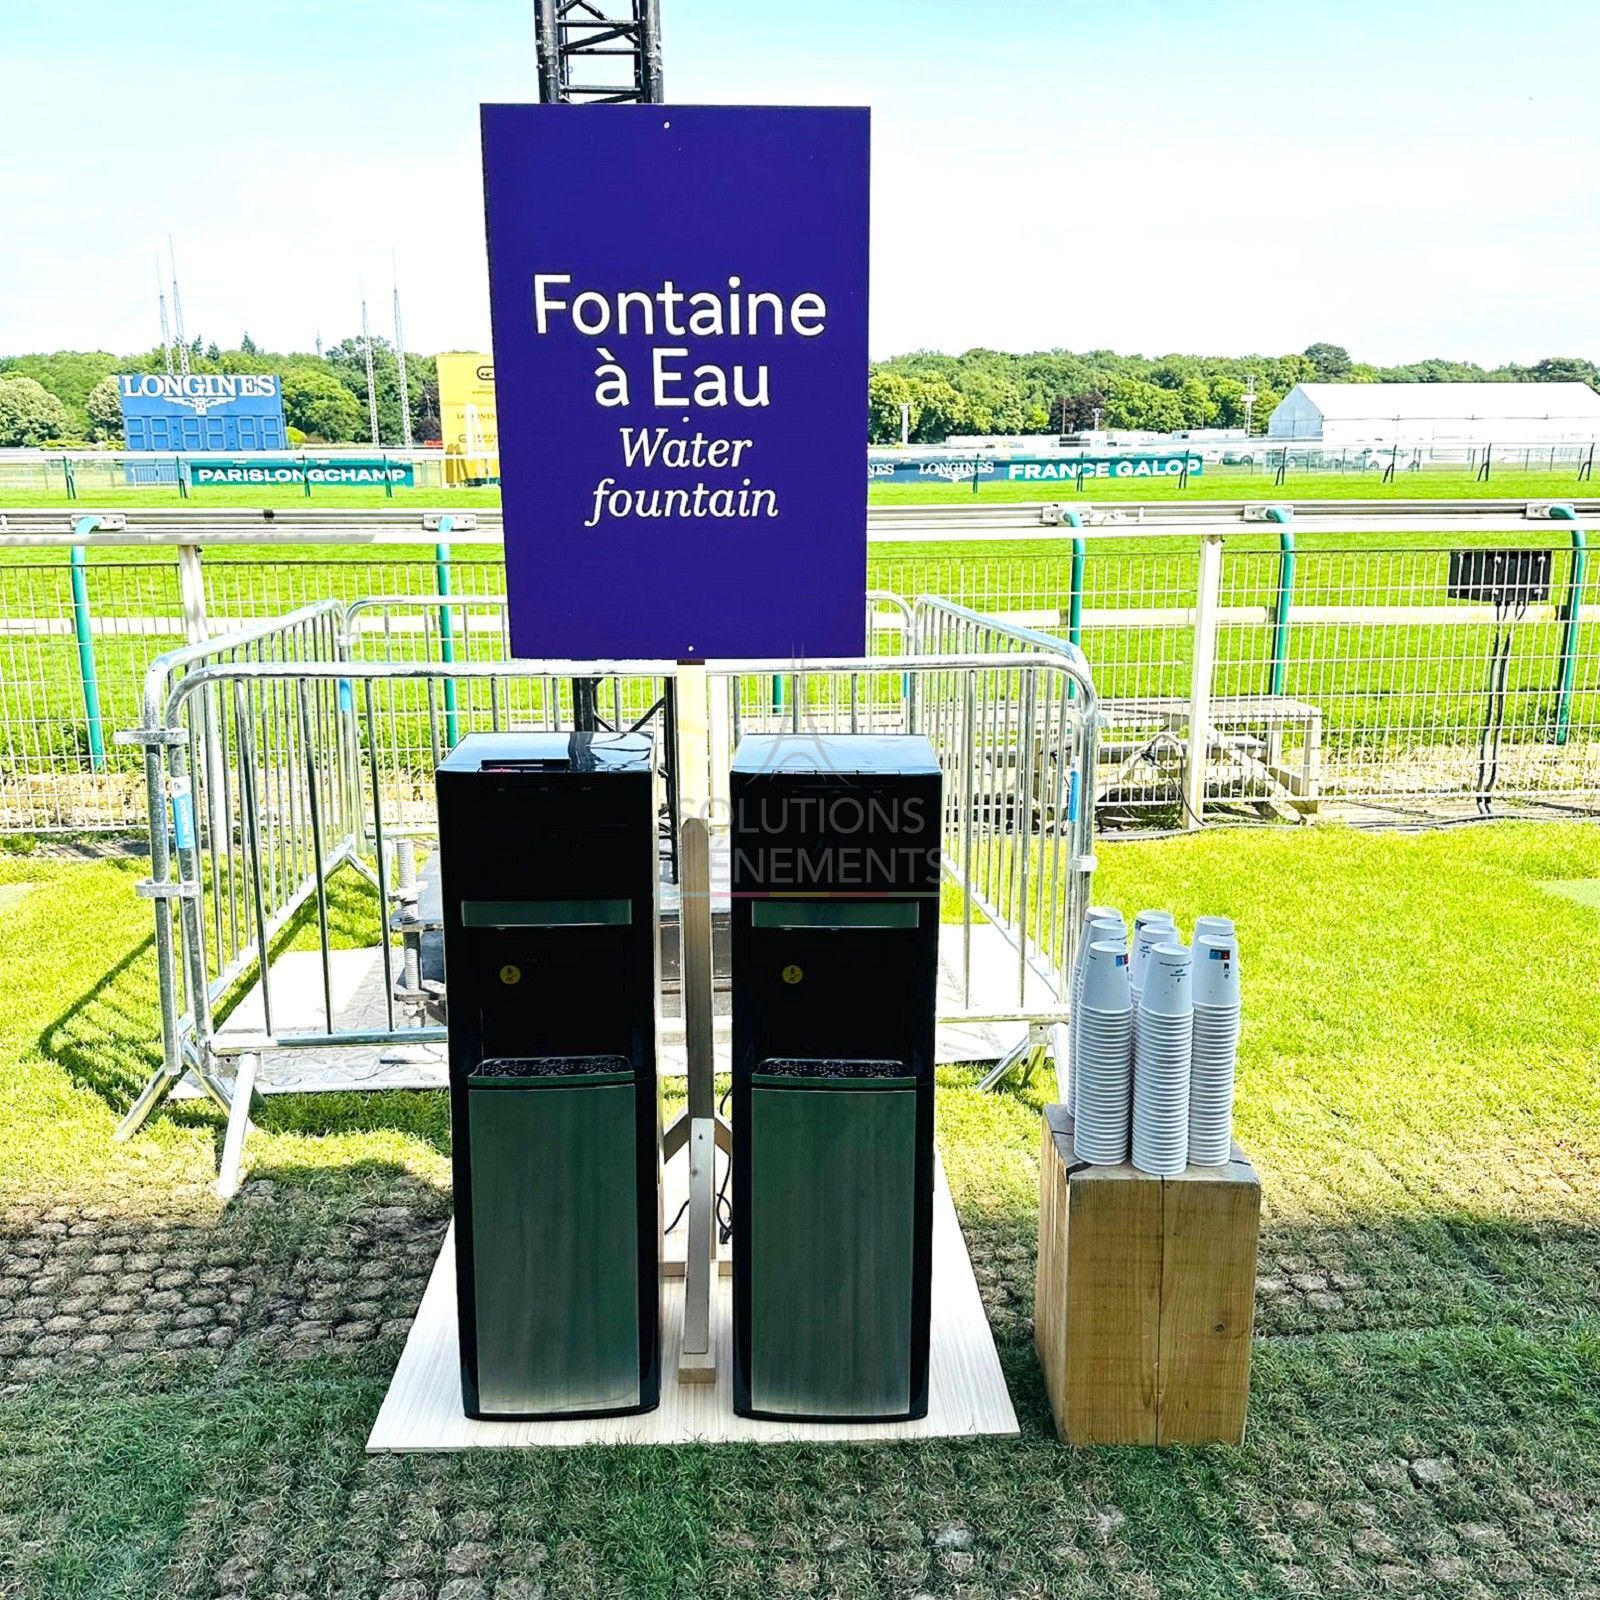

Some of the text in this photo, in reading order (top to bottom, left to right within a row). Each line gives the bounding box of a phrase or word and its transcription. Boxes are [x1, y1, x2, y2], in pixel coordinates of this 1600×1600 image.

[533, 273, 827, 338] Fontaine
[121, 374, 277, 398] LONGINES
[594, 346, 771, 408] à Eau
[619, 426, 754, 469] Water
[198, 467, 406, 483] PARISLONGCHAMP
[918, 461, 994, 475] LONGINES
[1008, 457, 1202, 480] FRANCE GALOP
[583, 478, 780, 529] fountain
